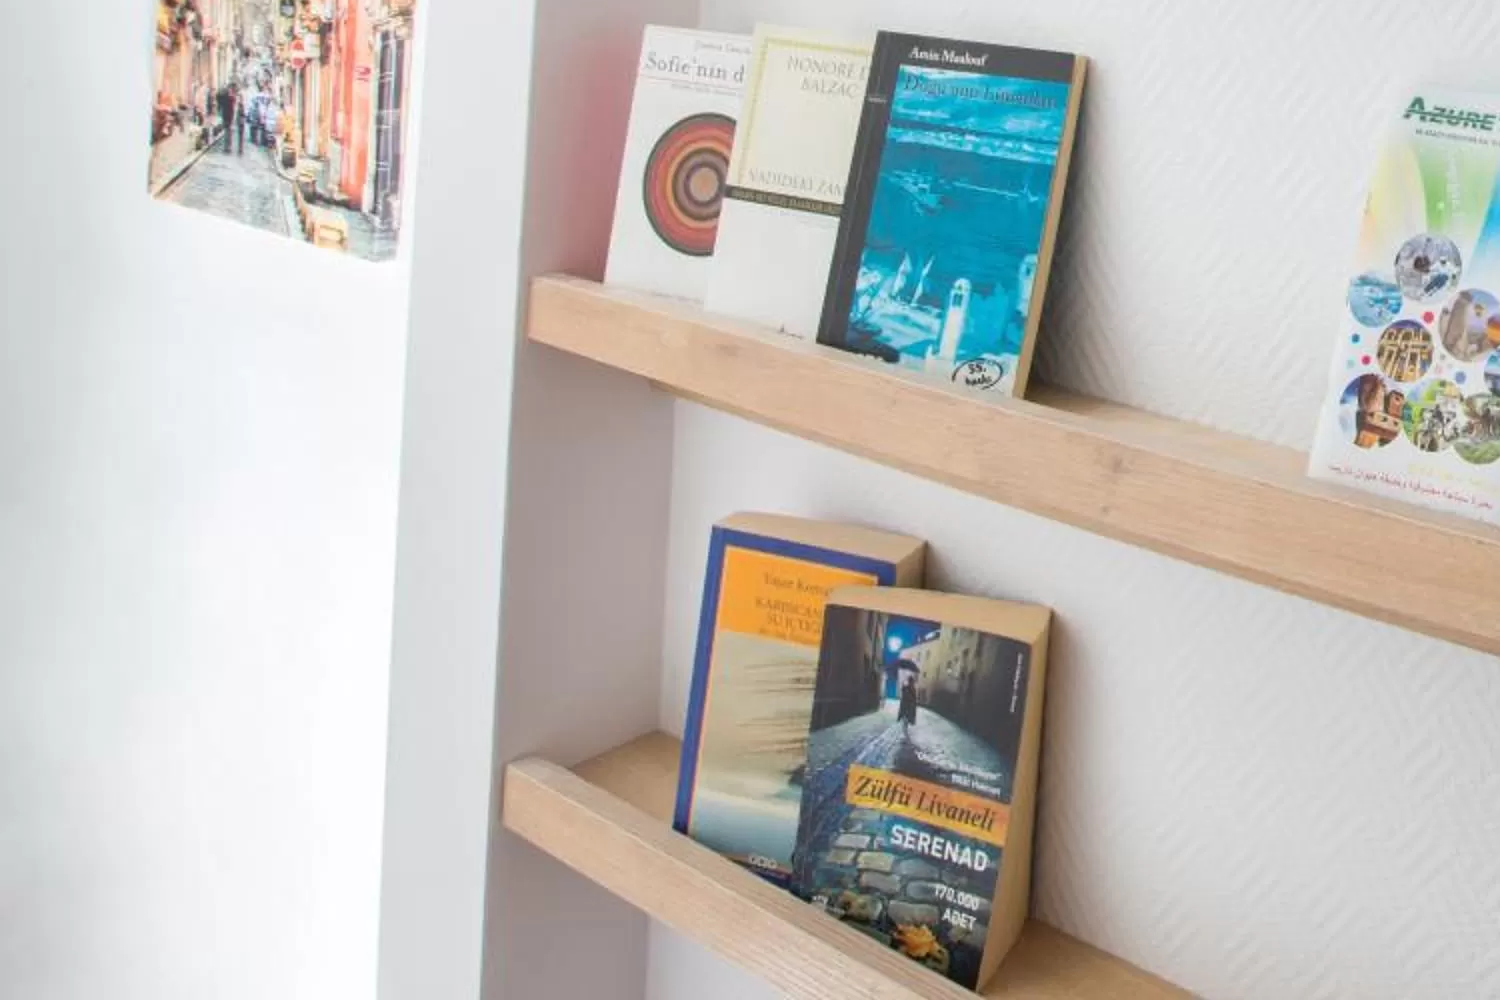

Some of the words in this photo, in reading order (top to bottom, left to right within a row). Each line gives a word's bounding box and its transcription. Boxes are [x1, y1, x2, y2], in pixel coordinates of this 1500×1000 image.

[1403, 96, 1496, 131] AZURE
[854, 775, 913, 808] Zülfü
[916, 791, 996, 833] Livaneli
[890, 823, 989, 872] SERENAD
[941, 907, 977, 931] ADET
